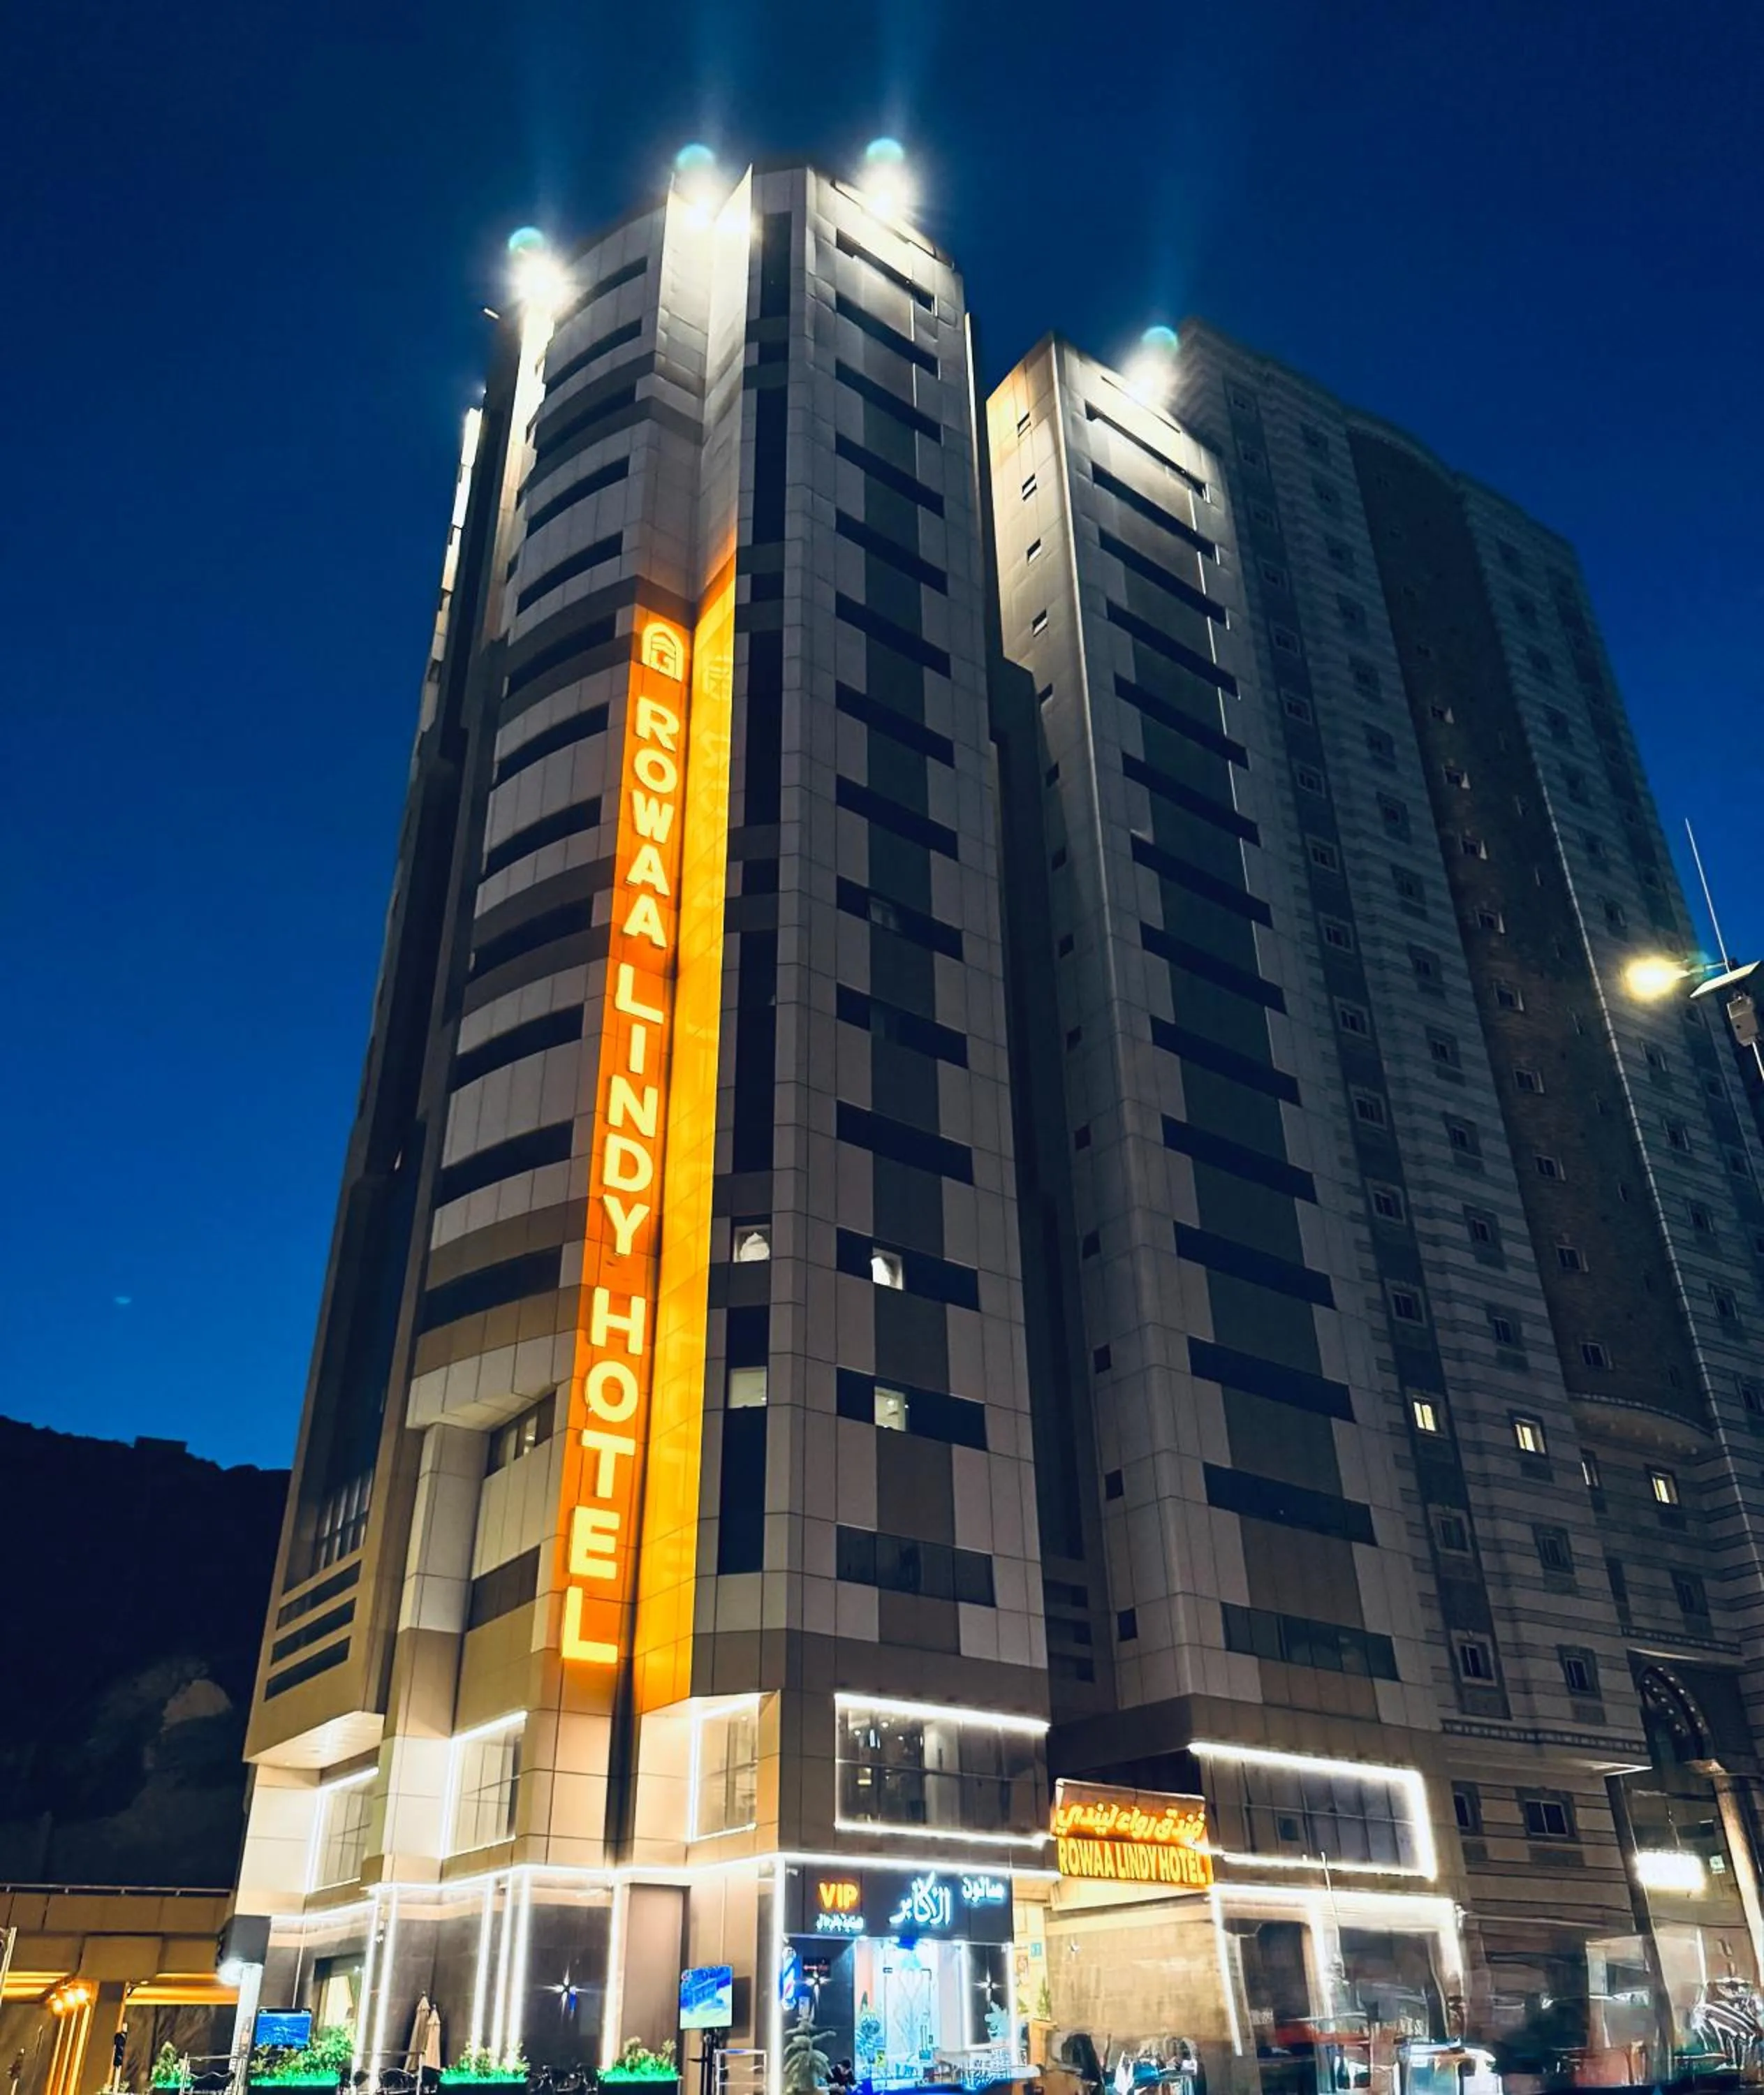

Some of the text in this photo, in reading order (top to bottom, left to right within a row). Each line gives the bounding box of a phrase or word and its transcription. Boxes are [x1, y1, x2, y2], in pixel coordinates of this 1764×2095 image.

[561, 696, 680, 1664] ROWAA LINDY HOTEL
[1055, 1802, 1119, 1836] ليندي
[1154, 1808, 1206, 1842] فندق
[1057, 1837, 1207, 1884] ROWAA LINDY HOTEL
[818, 1882, 858, 1909] VIP
[961, 1875, 1006, 1903] صالون
